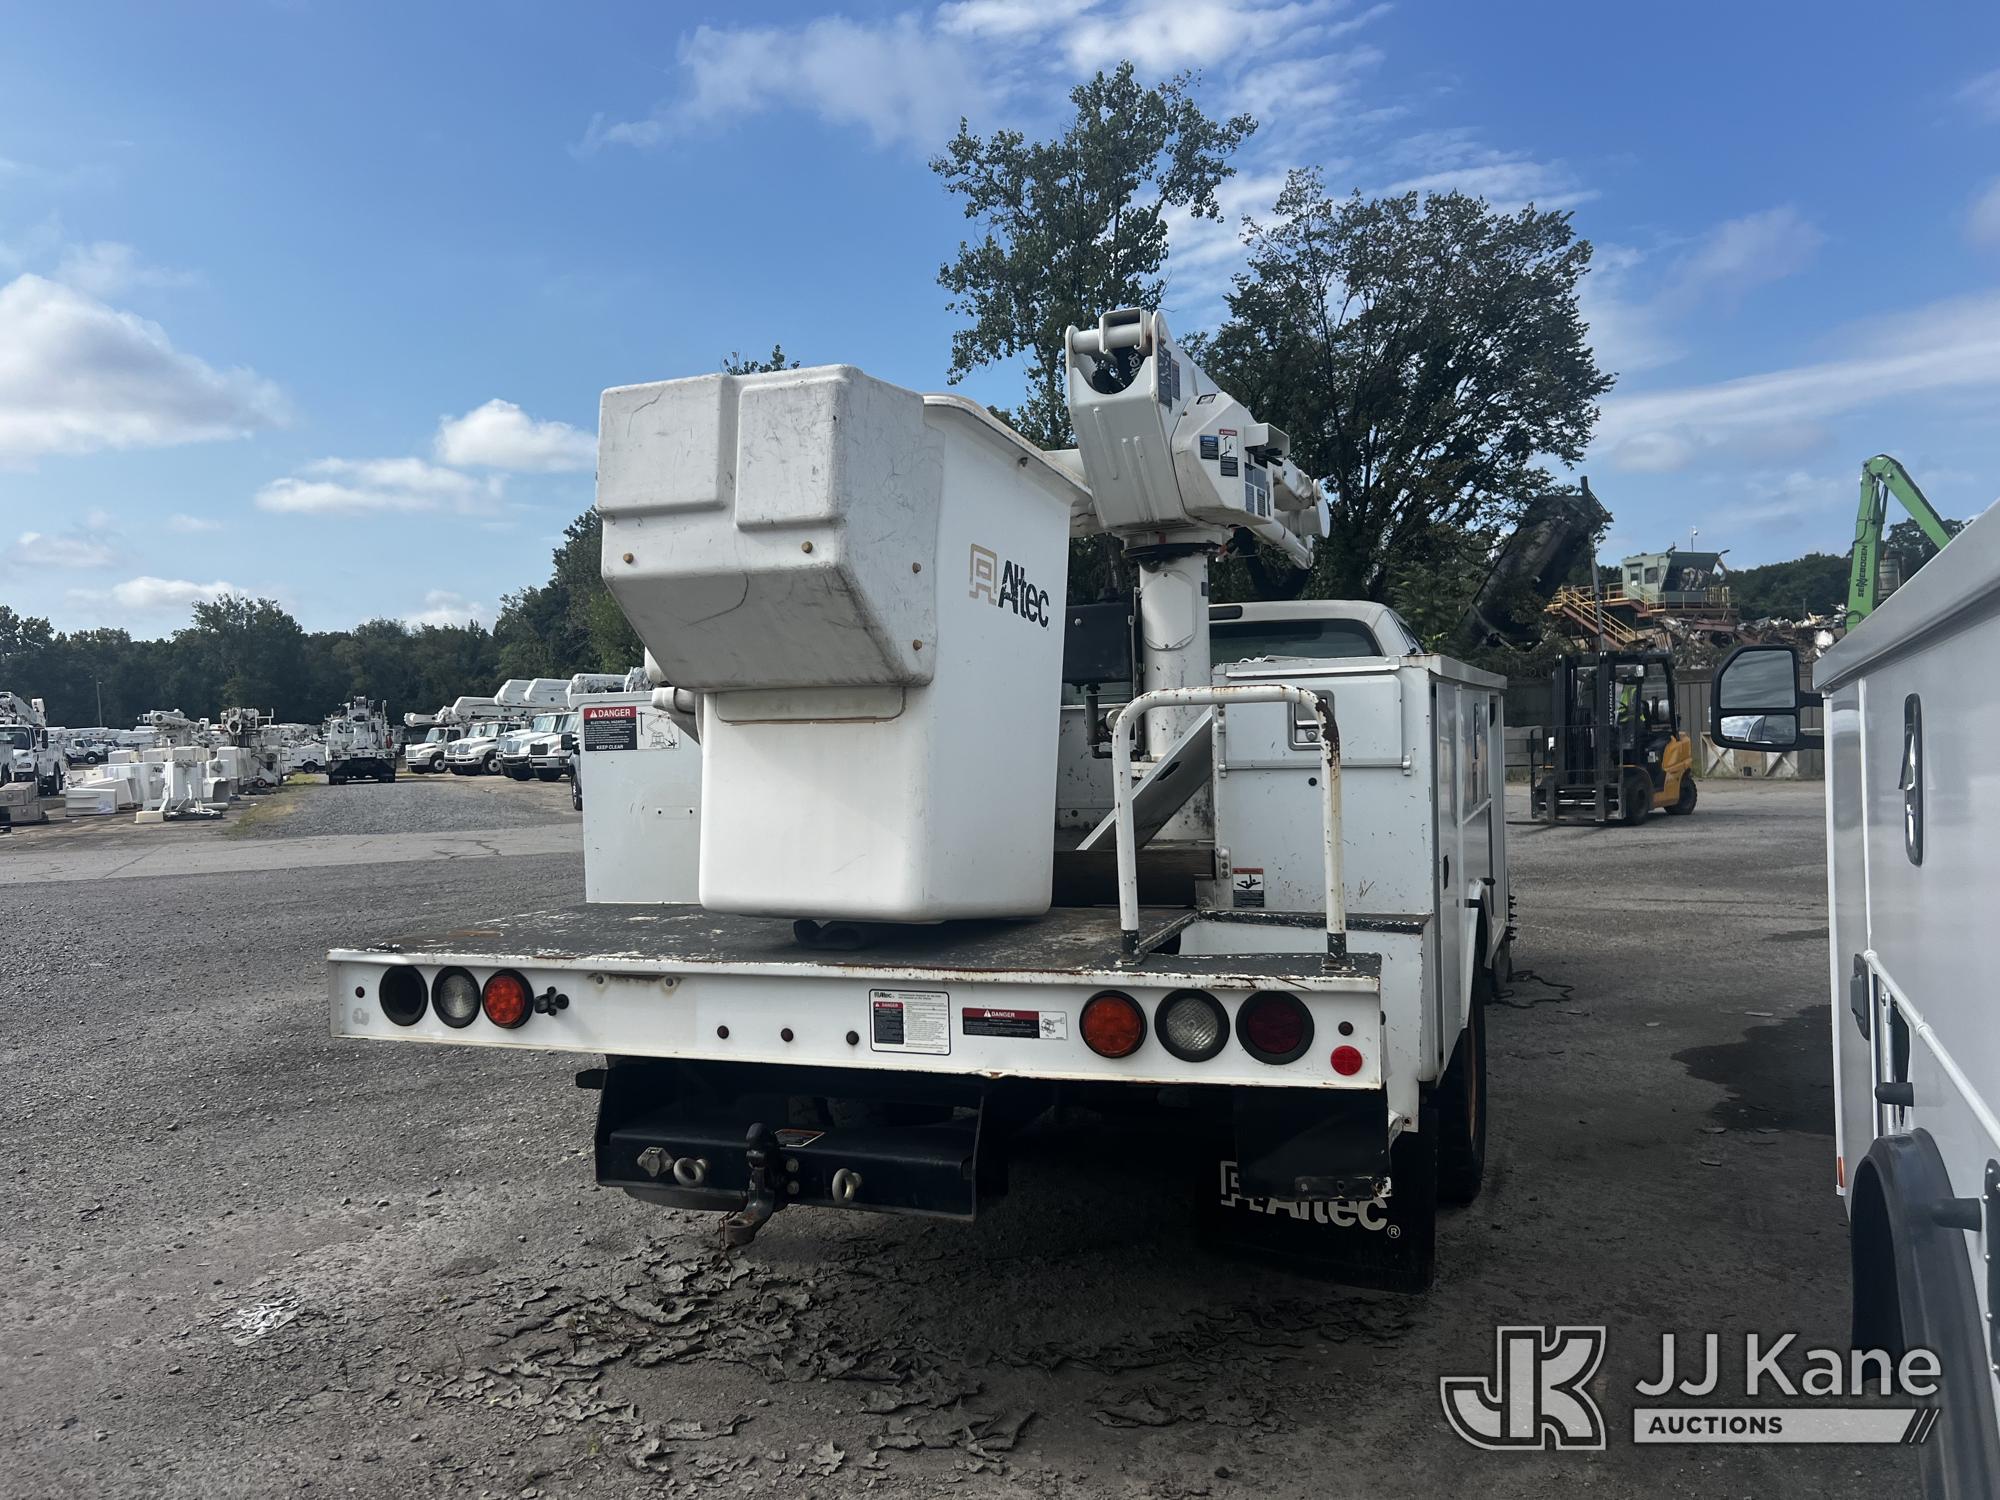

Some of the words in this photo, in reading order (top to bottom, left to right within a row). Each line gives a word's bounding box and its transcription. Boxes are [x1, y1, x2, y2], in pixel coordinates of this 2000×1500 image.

[998, 560, 1050, 628] Altec
[1856, 545, 1868, 598] SENNEBOGEN
[598, 708, 631, 718] DANGER
